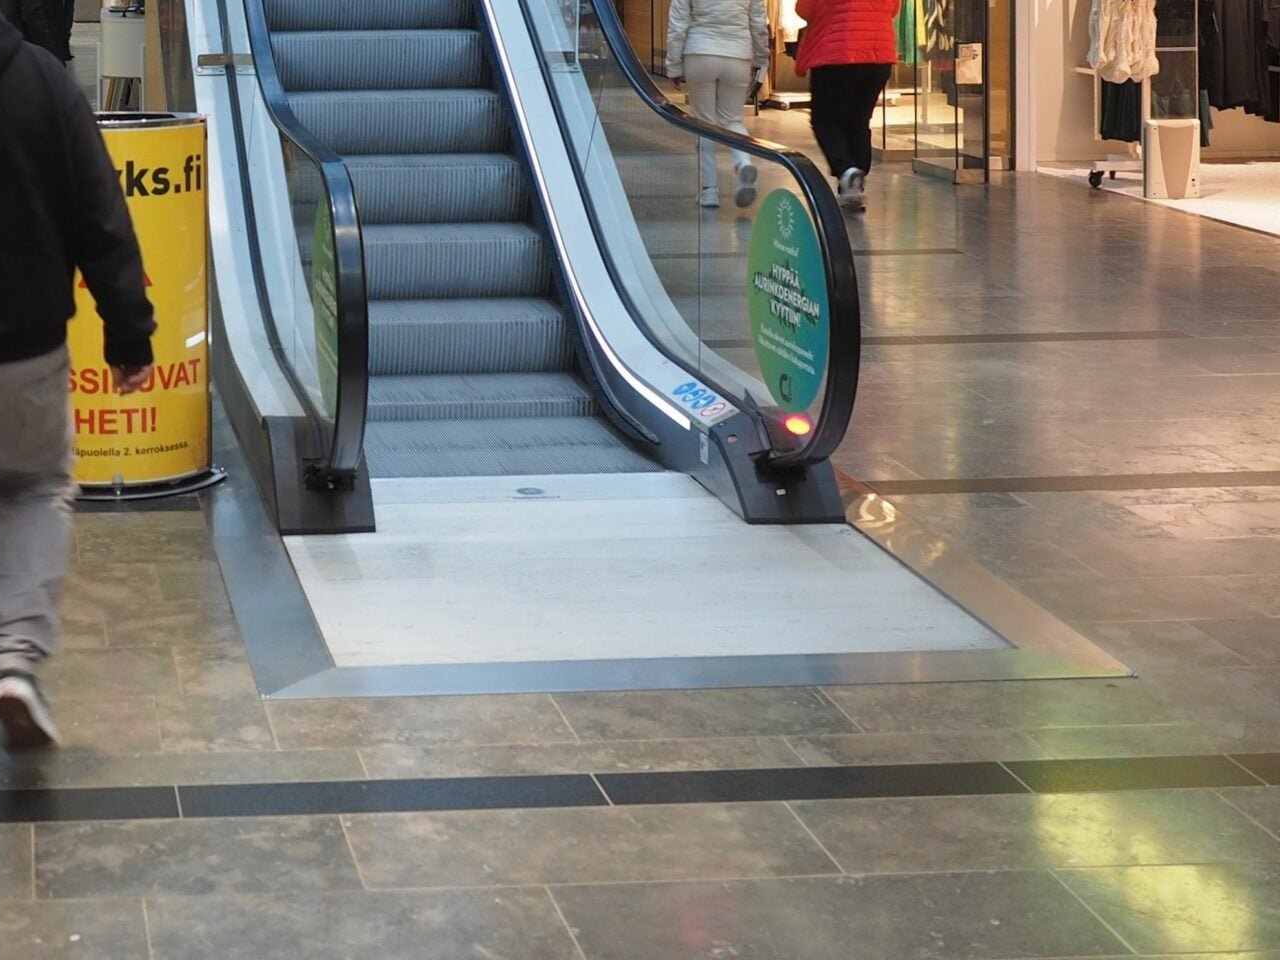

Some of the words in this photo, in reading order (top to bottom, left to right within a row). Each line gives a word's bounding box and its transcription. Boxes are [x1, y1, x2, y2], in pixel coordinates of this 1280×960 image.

[114, 155, 203, 197] ks.fi
[772, 263, 800, 289] HYPPÄÄ
[754, 274, 820, 318] AURINKOENERGIAN
[69, 358, 201, 394] SIUVAT
[75, 406, 157, 435] HETI!
